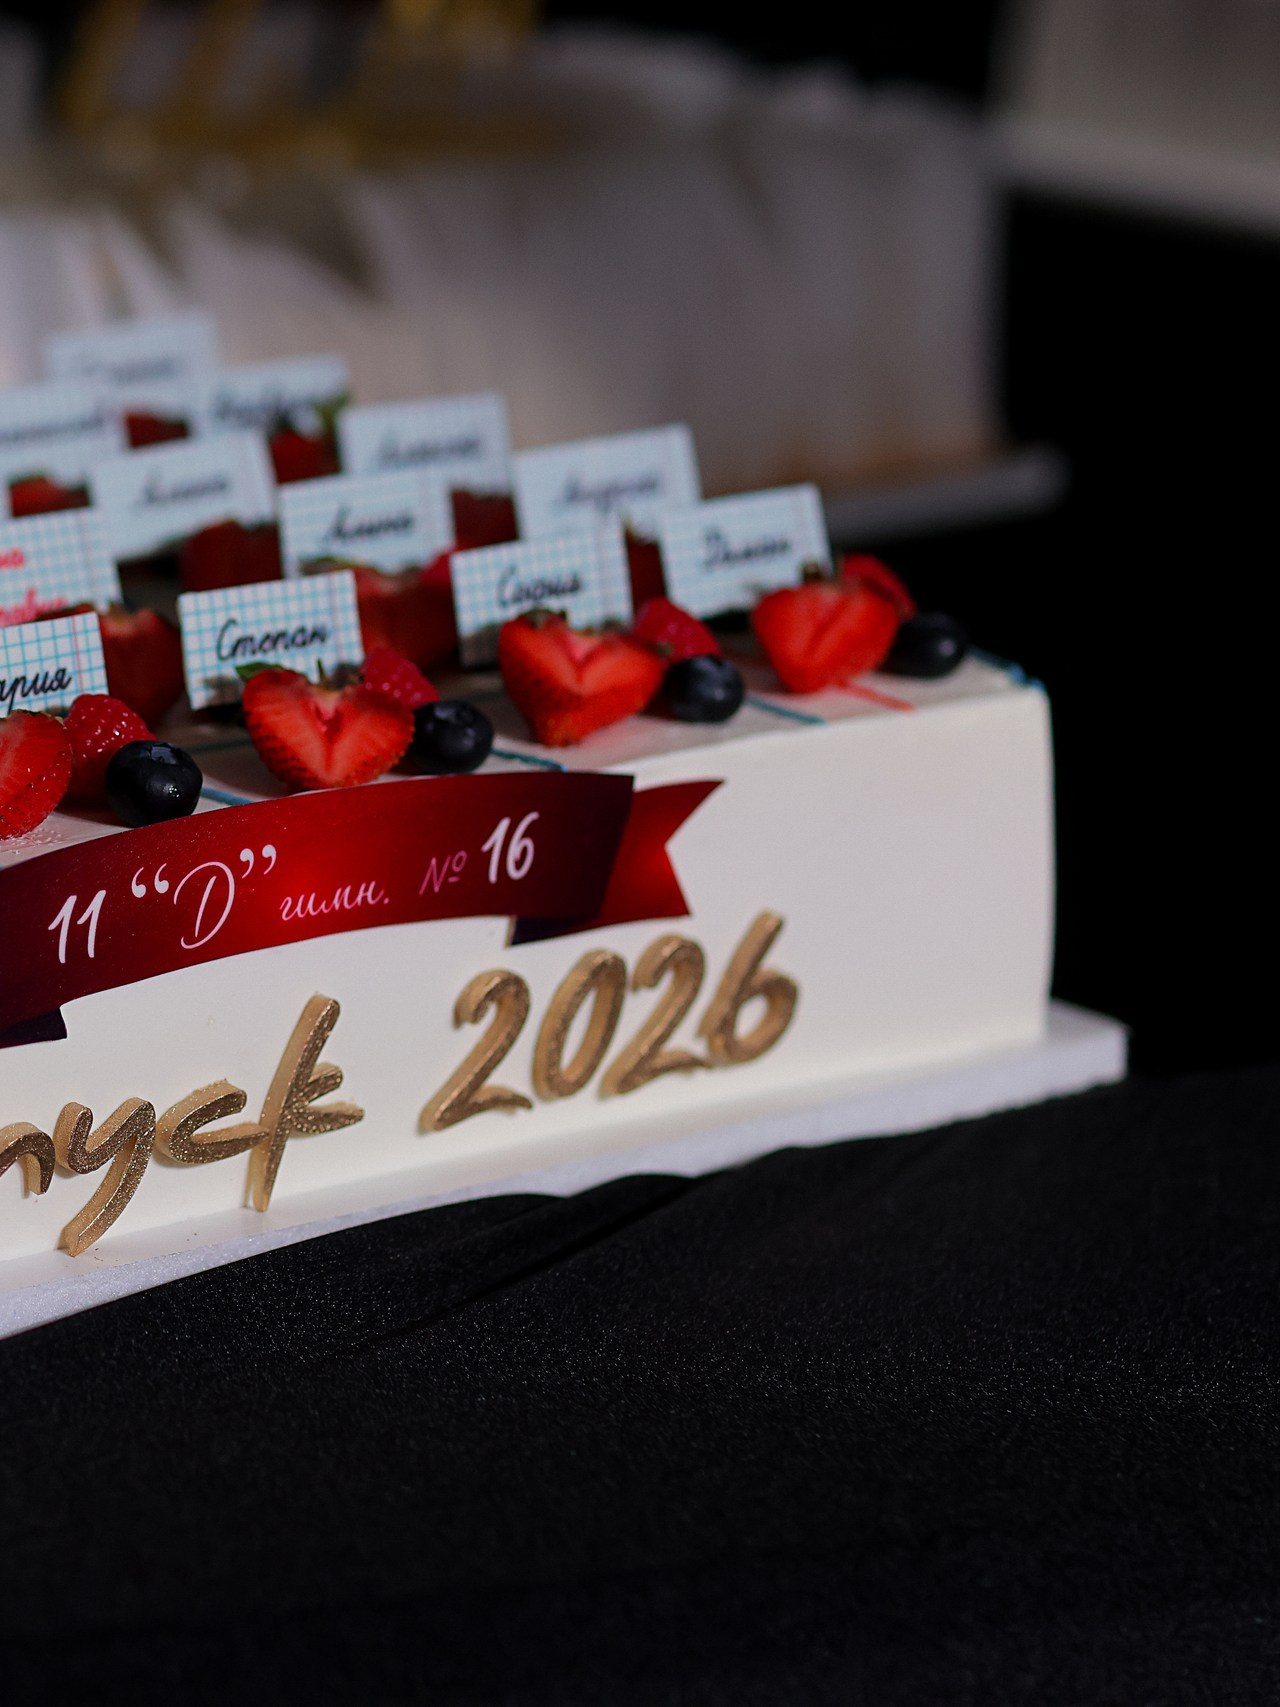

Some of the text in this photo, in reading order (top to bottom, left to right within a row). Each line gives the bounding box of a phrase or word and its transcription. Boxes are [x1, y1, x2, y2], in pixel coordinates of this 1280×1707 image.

[213, 617, 328, 661] Степан
[47, 889, 107, 964] 11
[279, 880, 390, 922] гимн.
[480, 810, 541, 885] 16
[417, 910, 800, 1134] 2026
